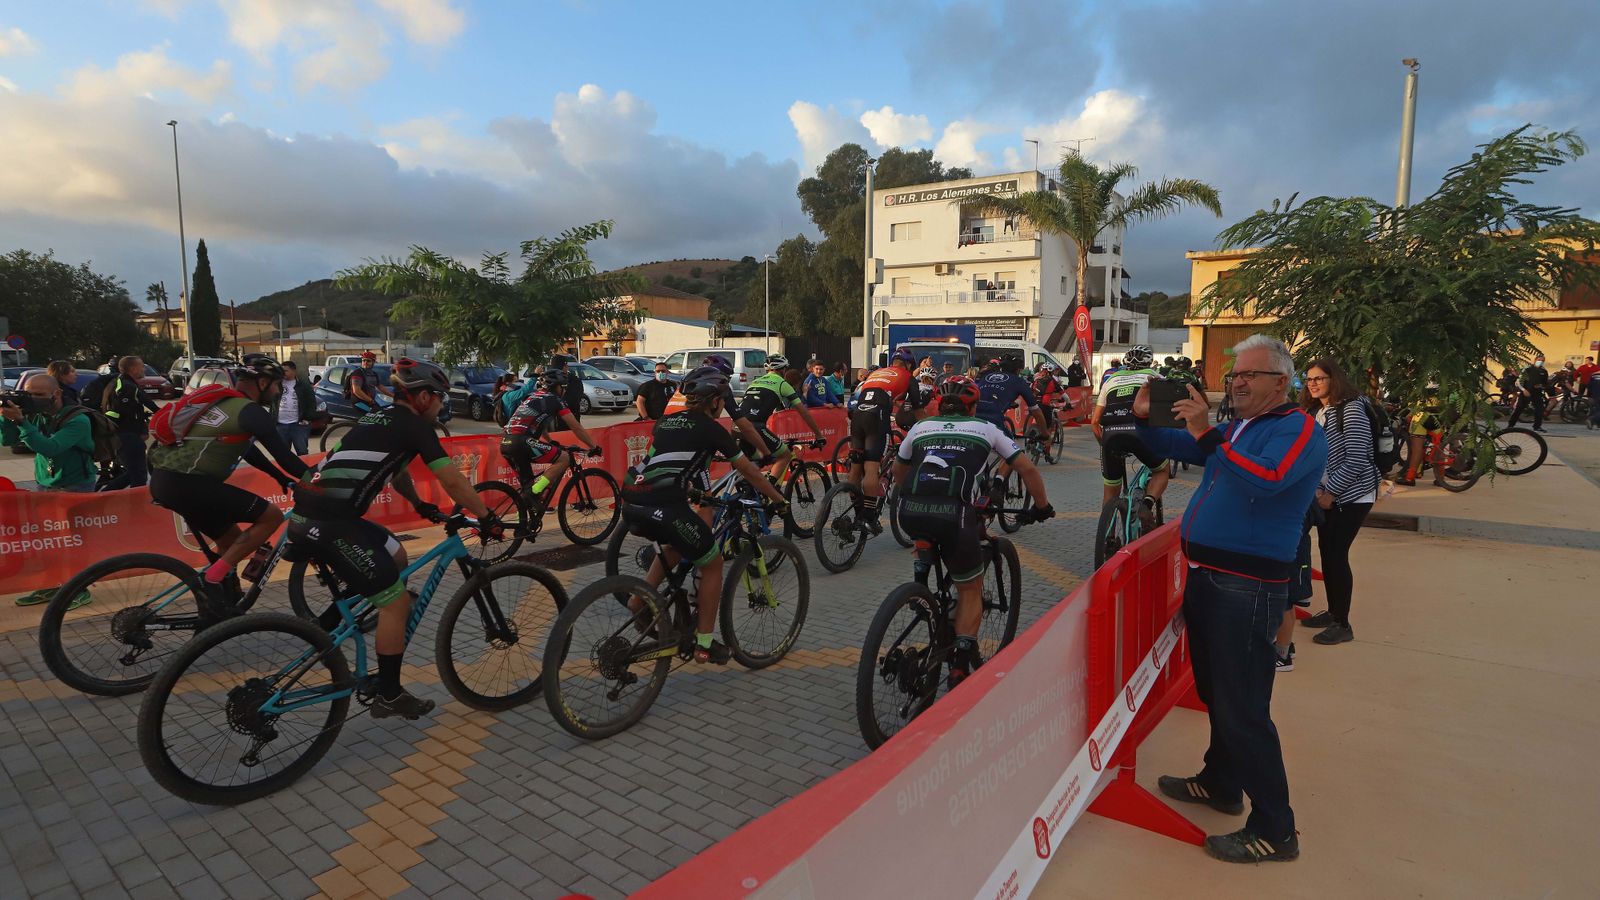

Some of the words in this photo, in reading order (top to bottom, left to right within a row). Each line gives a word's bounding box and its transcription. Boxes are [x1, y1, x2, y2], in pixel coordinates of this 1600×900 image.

[898, 195, 918, 204] H.R.
[921, 192, 938, 201] Los
[941, 186, 990, 199] Alemanes
[994, 183, 1015, 193] S.L.
[21, 522, 39, 535] de
[43, 519, 70, 532] San
[74, 514, 118, 528] Roque
[0, 534, 83, 554] DEPORTES
